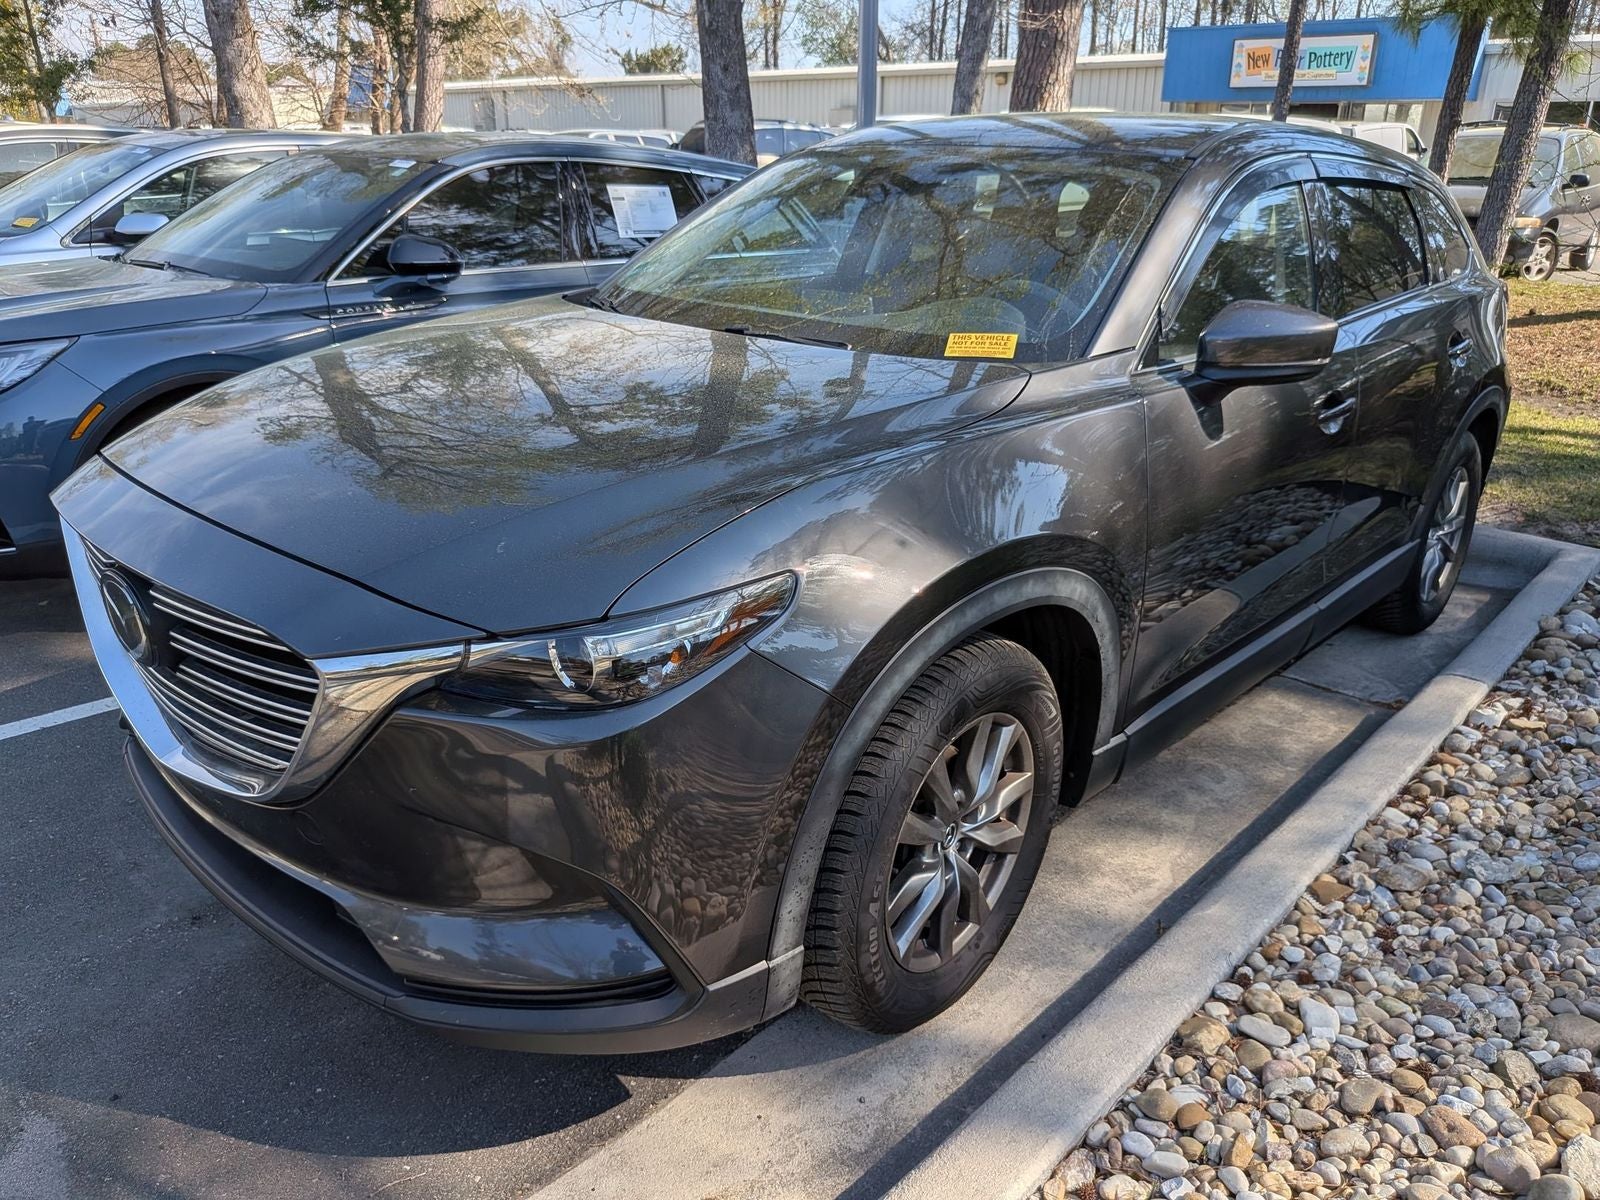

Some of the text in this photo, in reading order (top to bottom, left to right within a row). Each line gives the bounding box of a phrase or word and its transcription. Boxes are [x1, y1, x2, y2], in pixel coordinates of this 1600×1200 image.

[1247, 51, 1271, 70] New
[1308, 50, 1353, 70] Pottery
[974, 334, 1012, 342] VEHICLE
